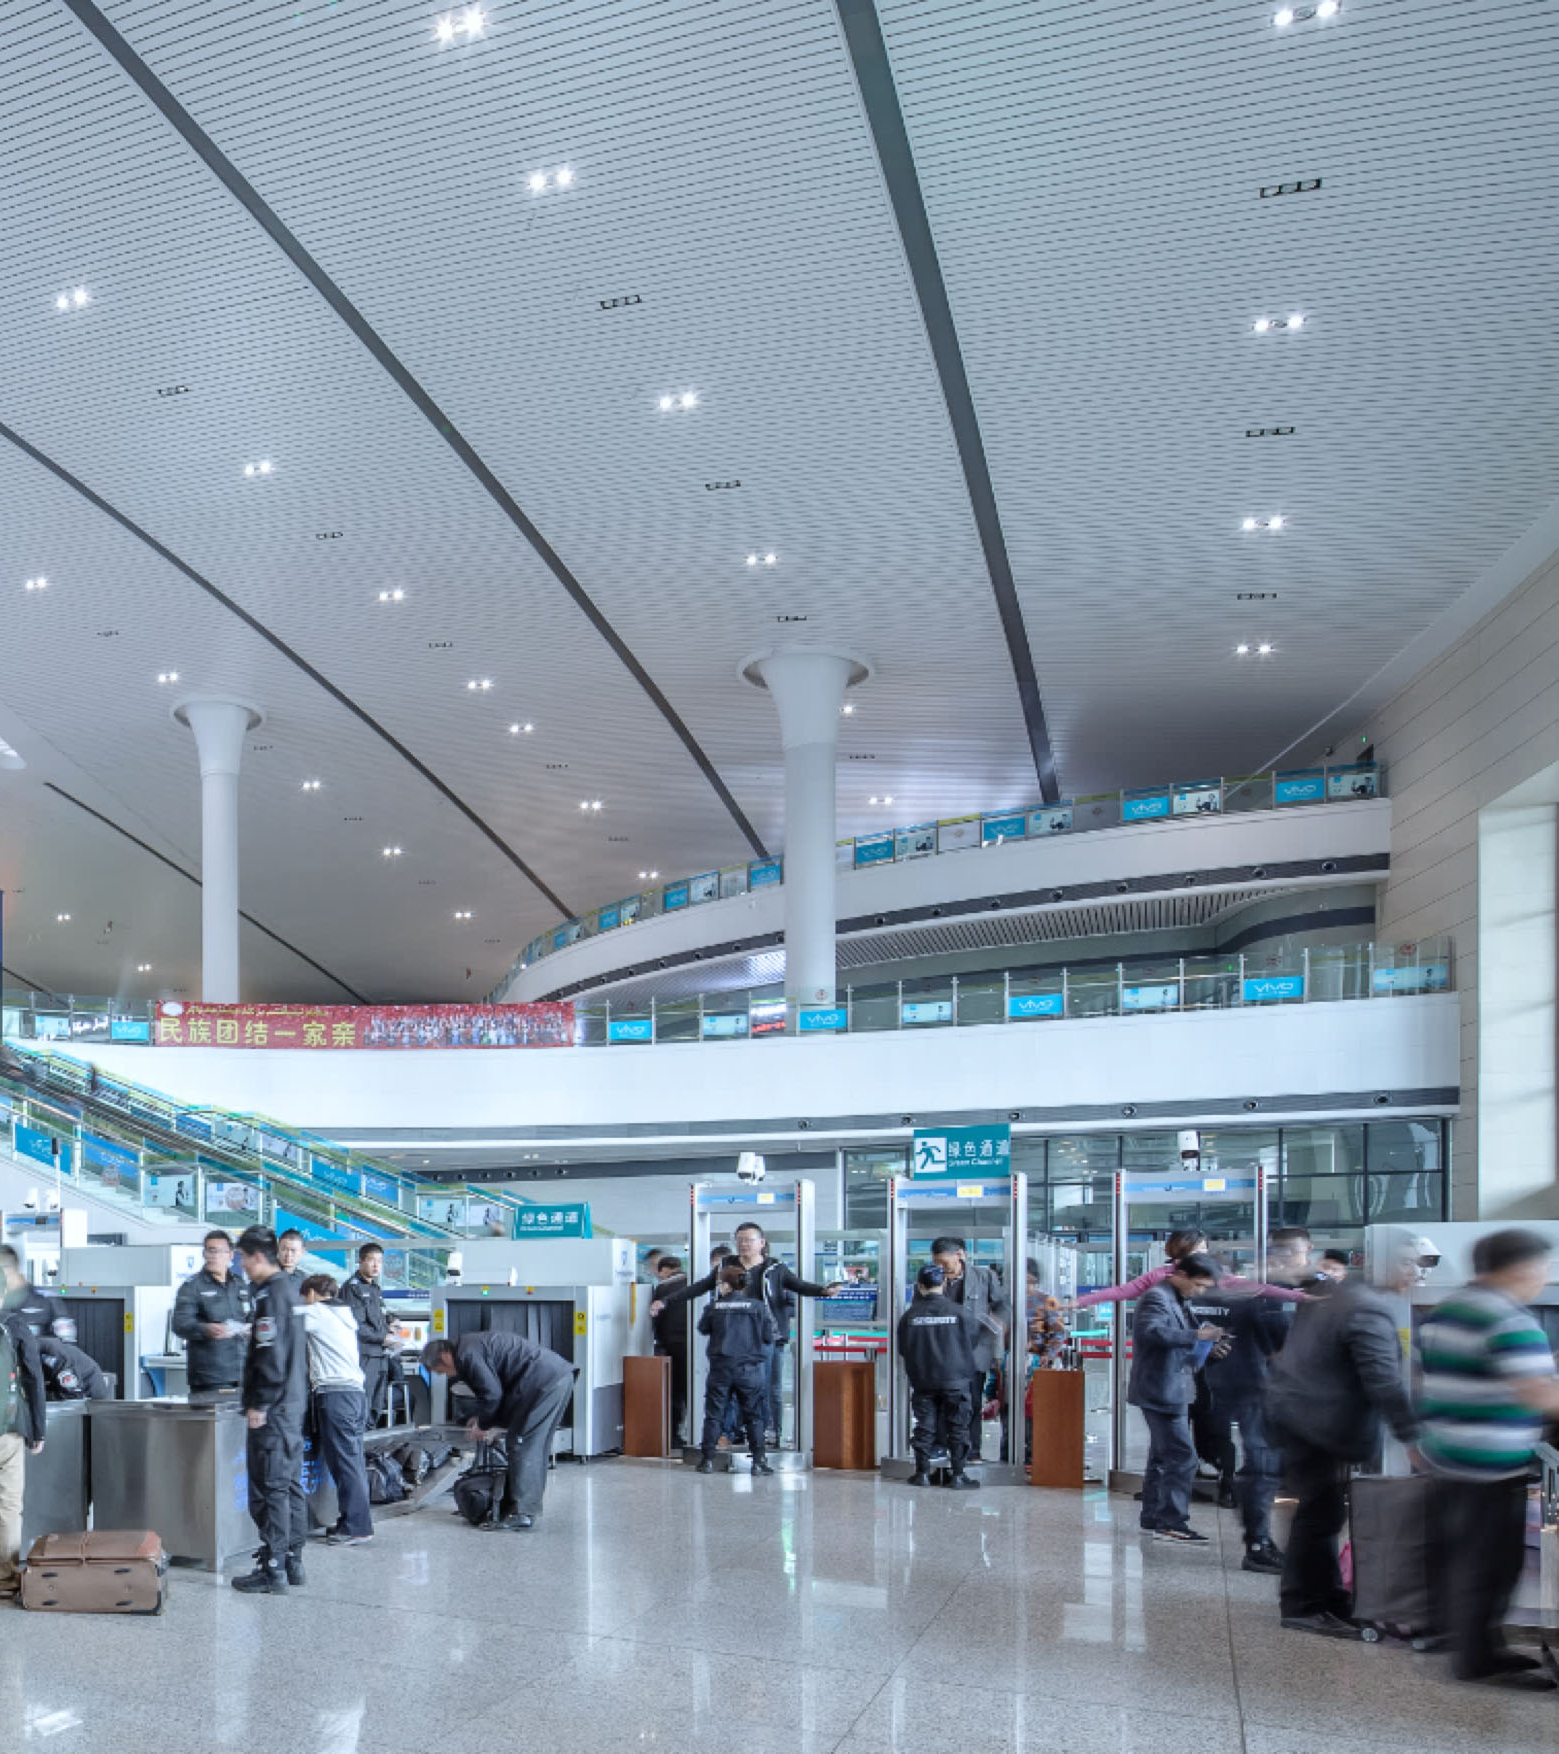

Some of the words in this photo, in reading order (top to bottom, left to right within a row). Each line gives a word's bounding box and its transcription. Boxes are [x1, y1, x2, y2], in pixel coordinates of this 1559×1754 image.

[1254, 982, 1294, 993] vivo
[1019, 998, 1053, 1010] vivo
[807, 1013, 839, 1025] vivo
[115, 1023, 141, 1034] vivo
[159, 1017, 356, 1047] 民族团结一家亲
[616, 1023, 647, 1035] vivo
[948, 1139, 1009, 1158] 绿色通道
[913, 1316, 957, 1326] SECURITY
